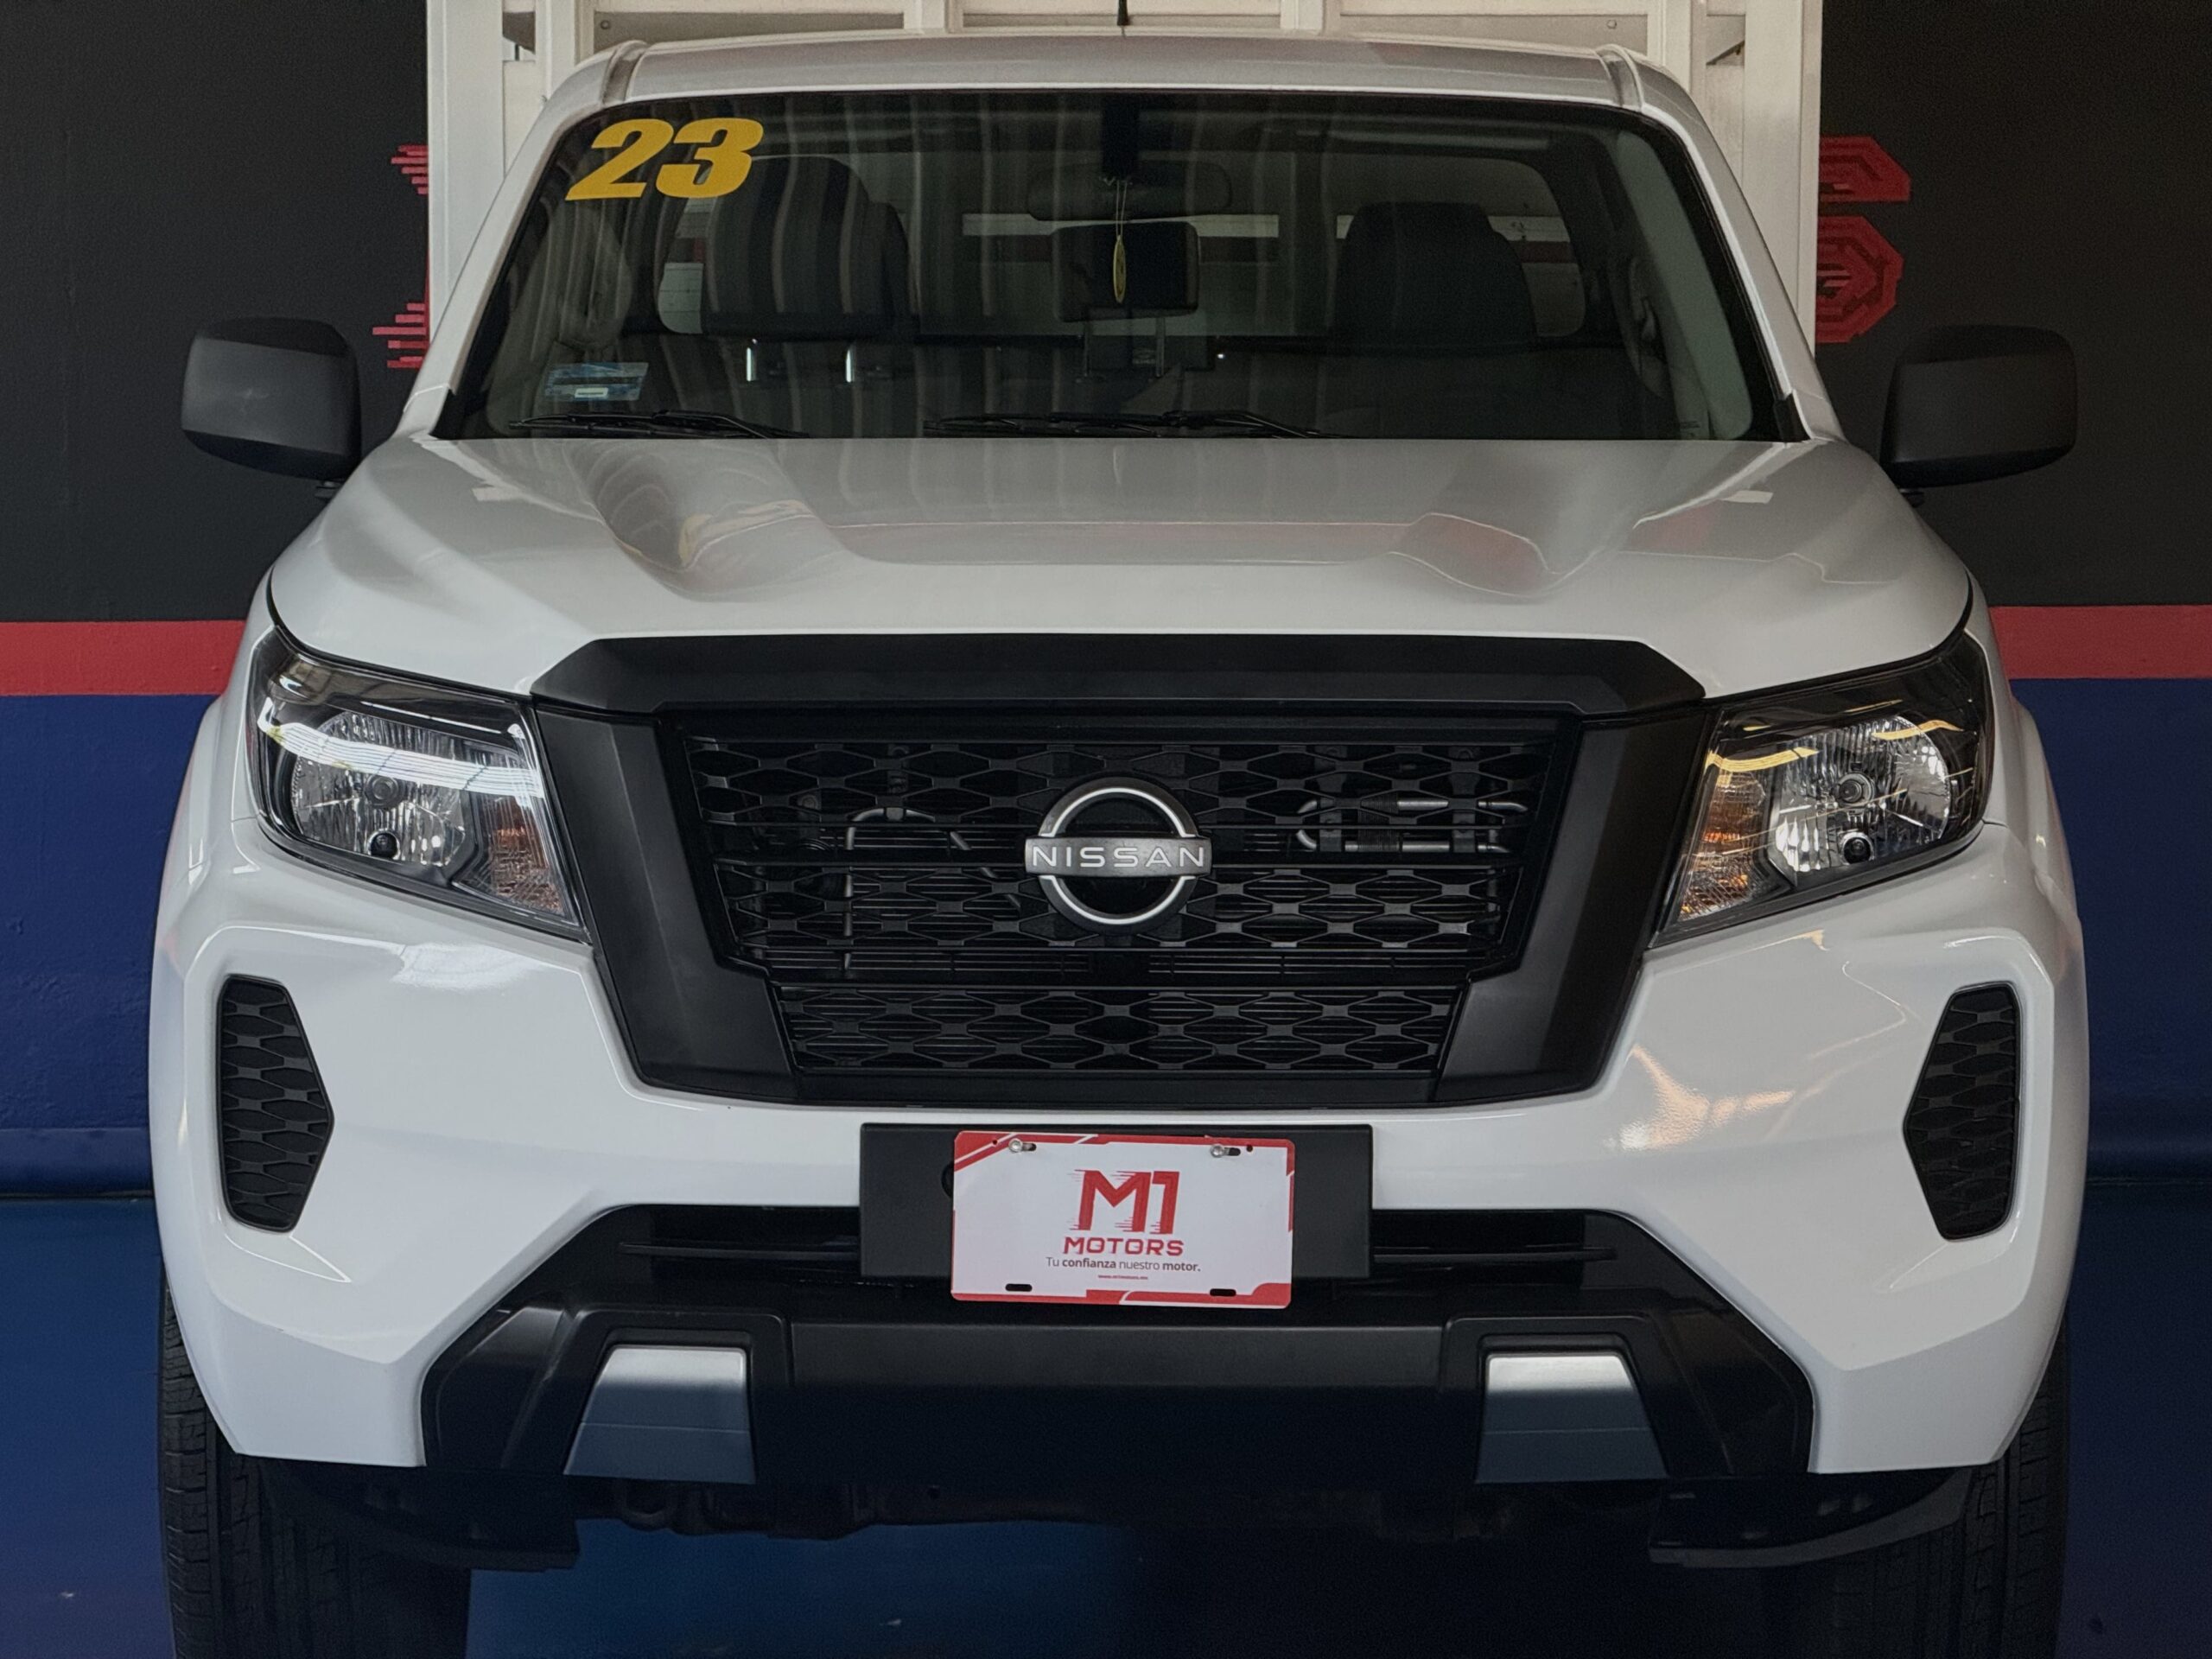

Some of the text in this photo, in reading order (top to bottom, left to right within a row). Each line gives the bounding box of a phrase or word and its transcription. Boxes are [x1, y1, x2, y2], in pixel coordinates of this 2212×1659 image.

[565, 118, 764, 200] 23
[1033, 847, 1204, 868] NISSAN
[1069, 1169, 1179, 1235] M1
[1063, 1236, 1184, 1256] MOTORS
[1046, 1257, 1201, 1272] Tu confianza nuestro motor.
